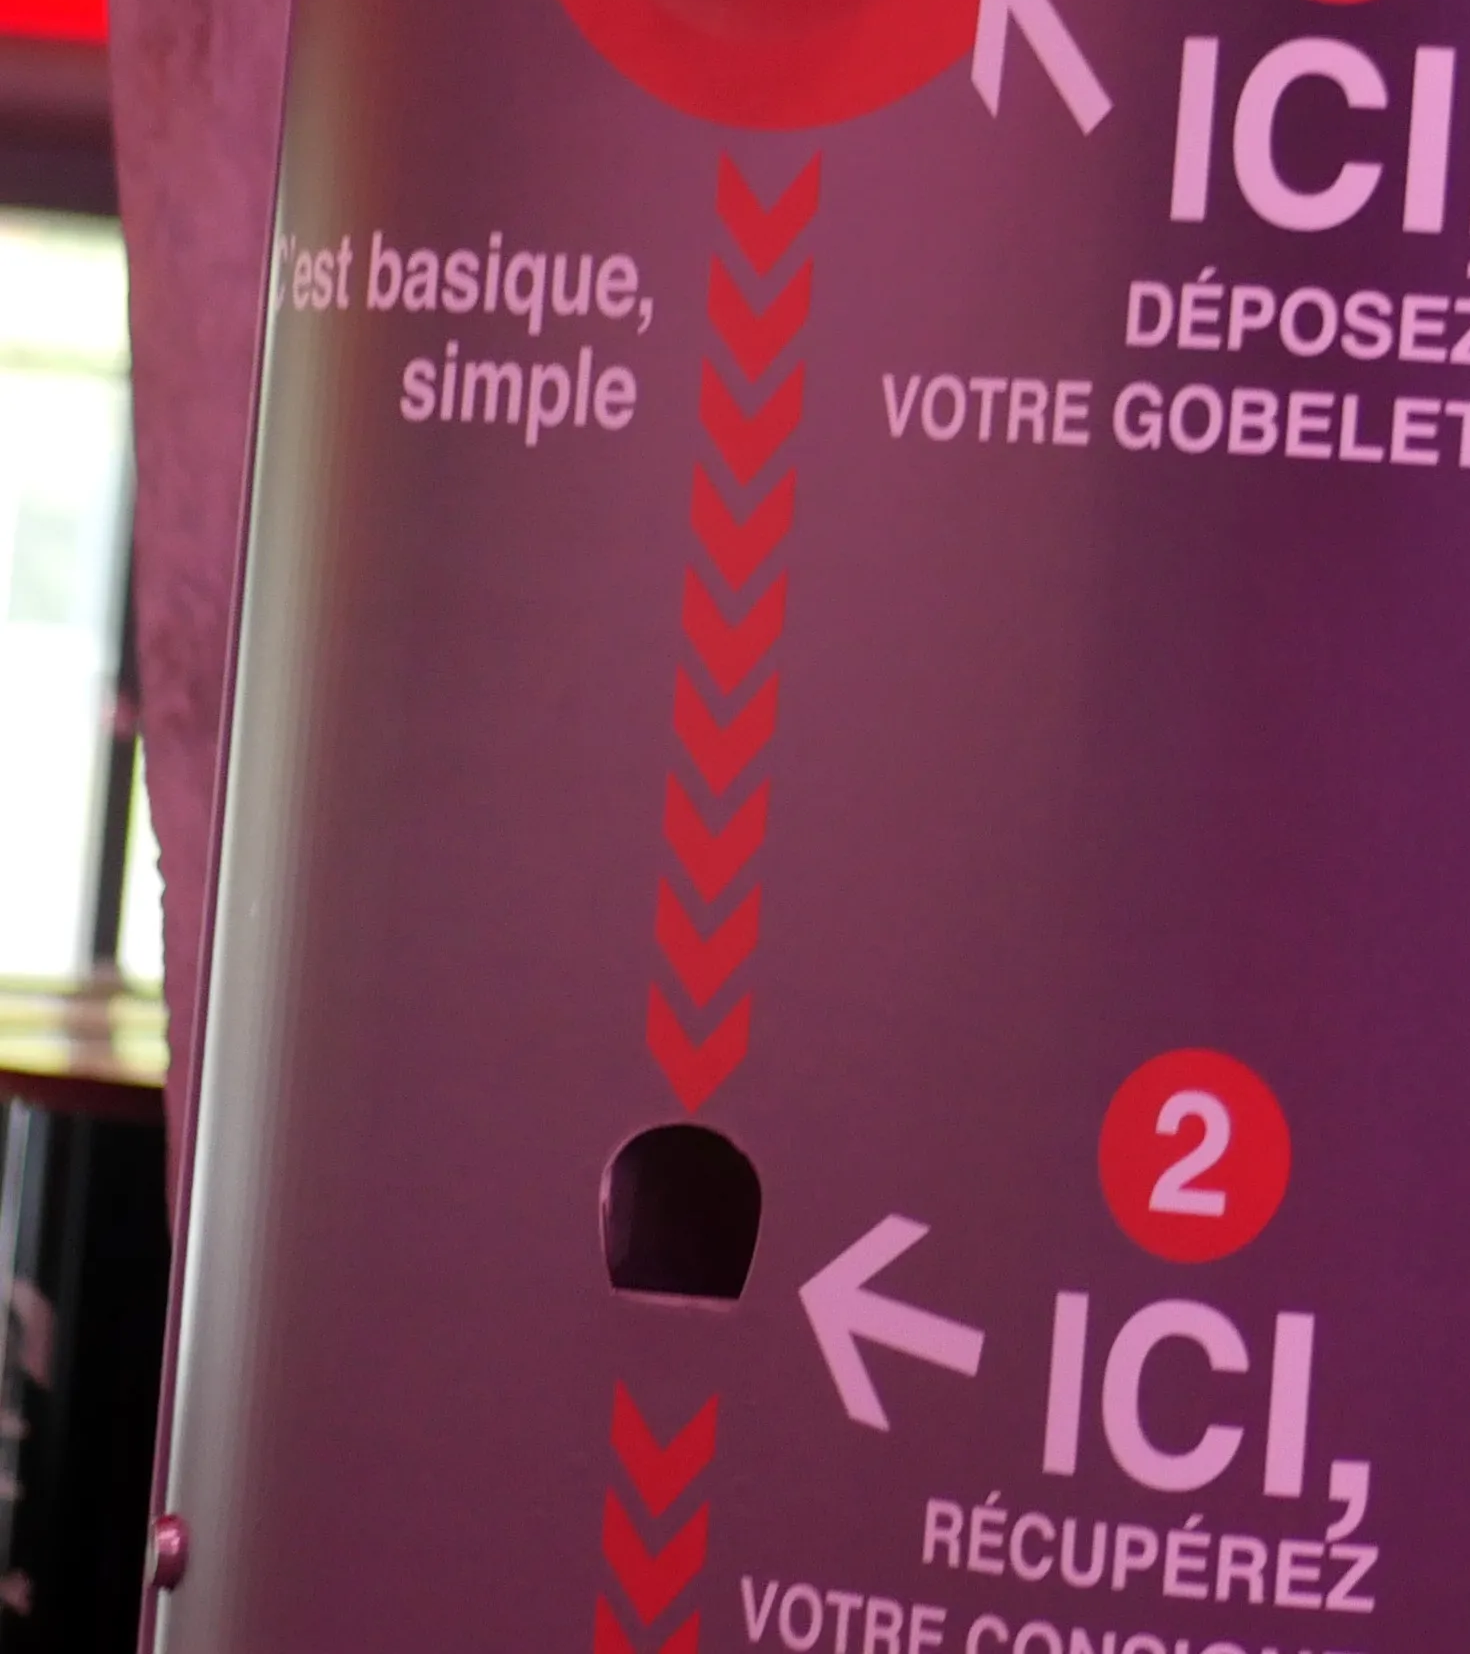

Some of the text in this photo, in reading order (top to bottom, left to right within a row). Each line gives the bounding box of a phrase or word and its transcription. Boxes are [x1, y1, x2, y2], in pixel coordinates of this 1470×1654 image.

[367, 231, 652, 335] basique,
[401, 342, 636, 446] simple
[883, 374, 1092, 445] VOTRE
[1150, 1091, 1230, 1215] 2
[1043, 1292, 1370, 1541] ICI,
[922, 1491, 1379, 1613] RÉCUPÉREZ
[742, 1577, 946, 1654] VOTRE
